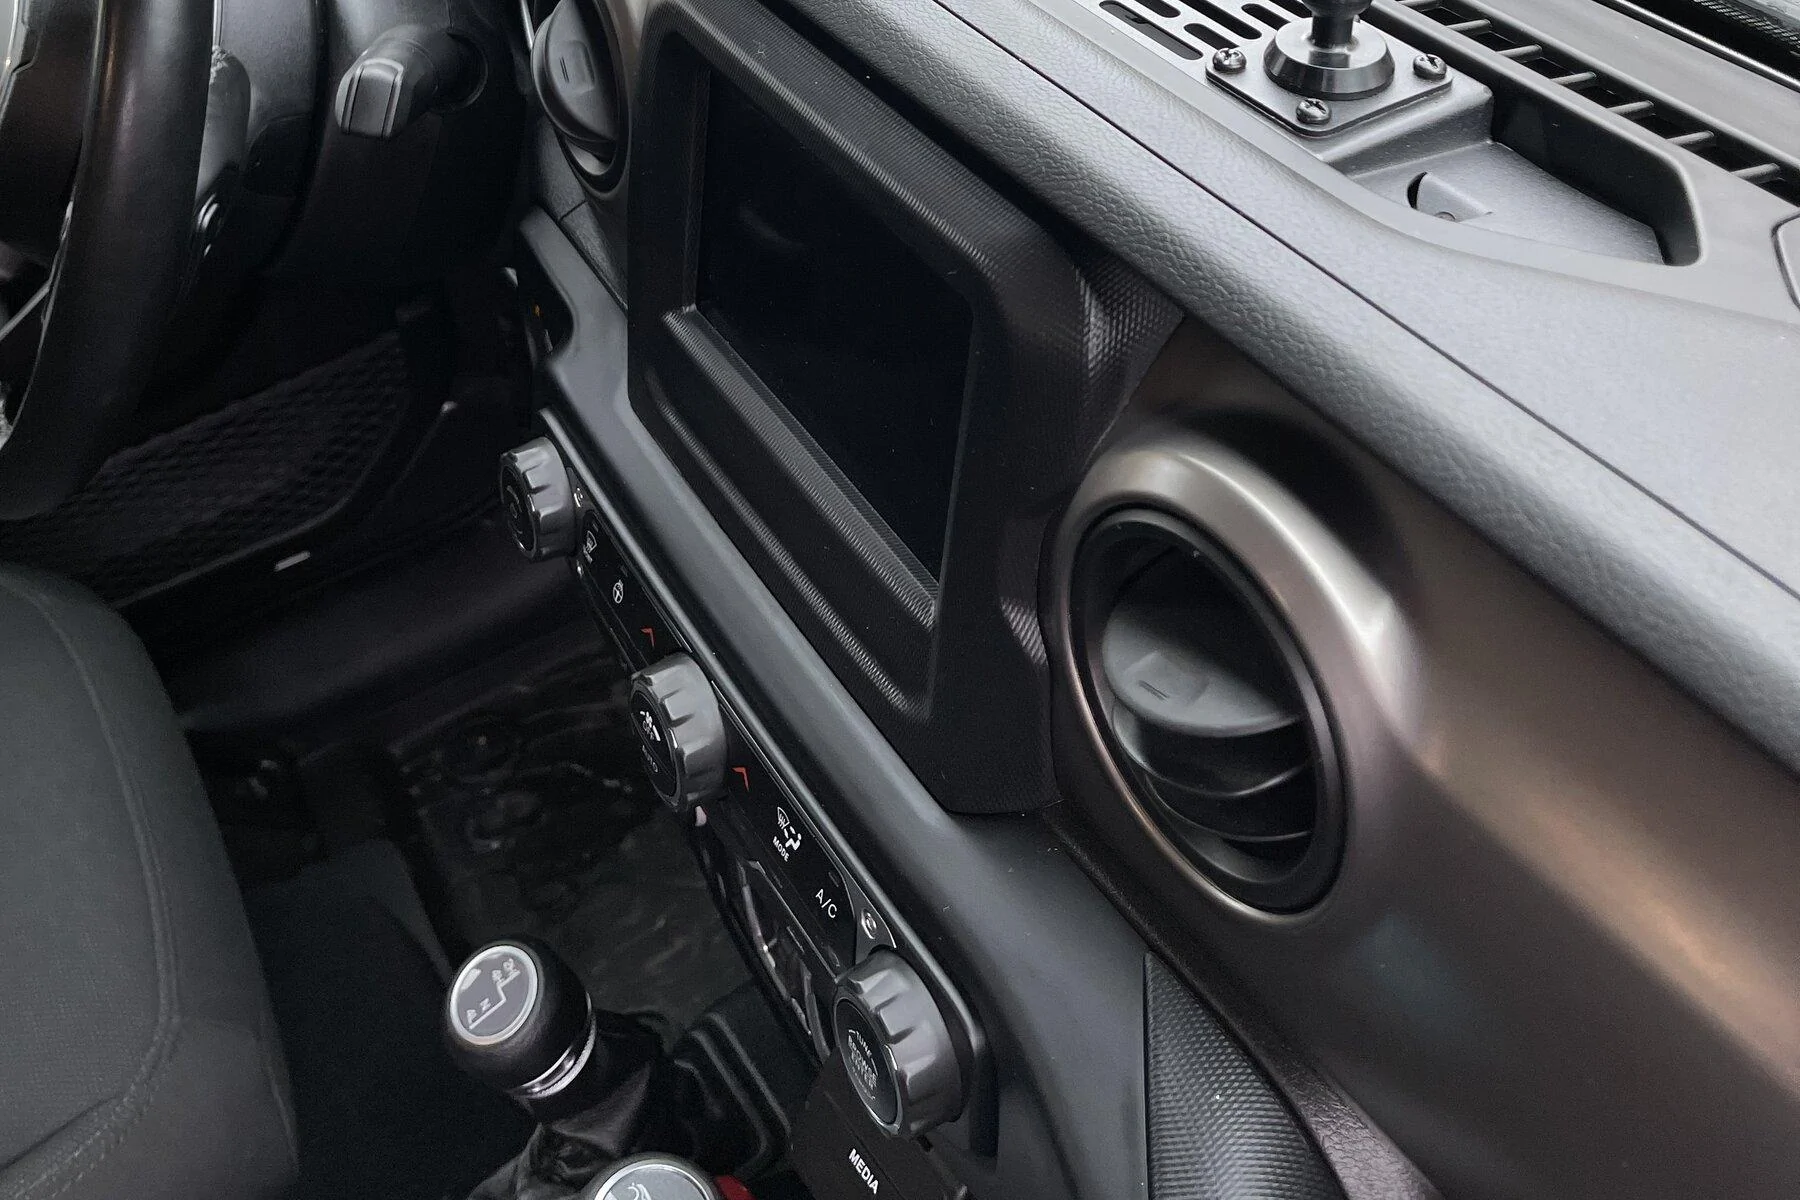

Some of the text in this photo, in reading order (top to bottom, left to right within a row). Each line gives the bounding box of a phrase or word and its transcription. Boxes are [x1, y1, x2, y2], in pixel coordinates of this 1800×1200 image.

[772, 835, 789, 862] MODE
[815, 888, 838, 919] A/C
[848, 1148, 879, 1195] MEDIA
